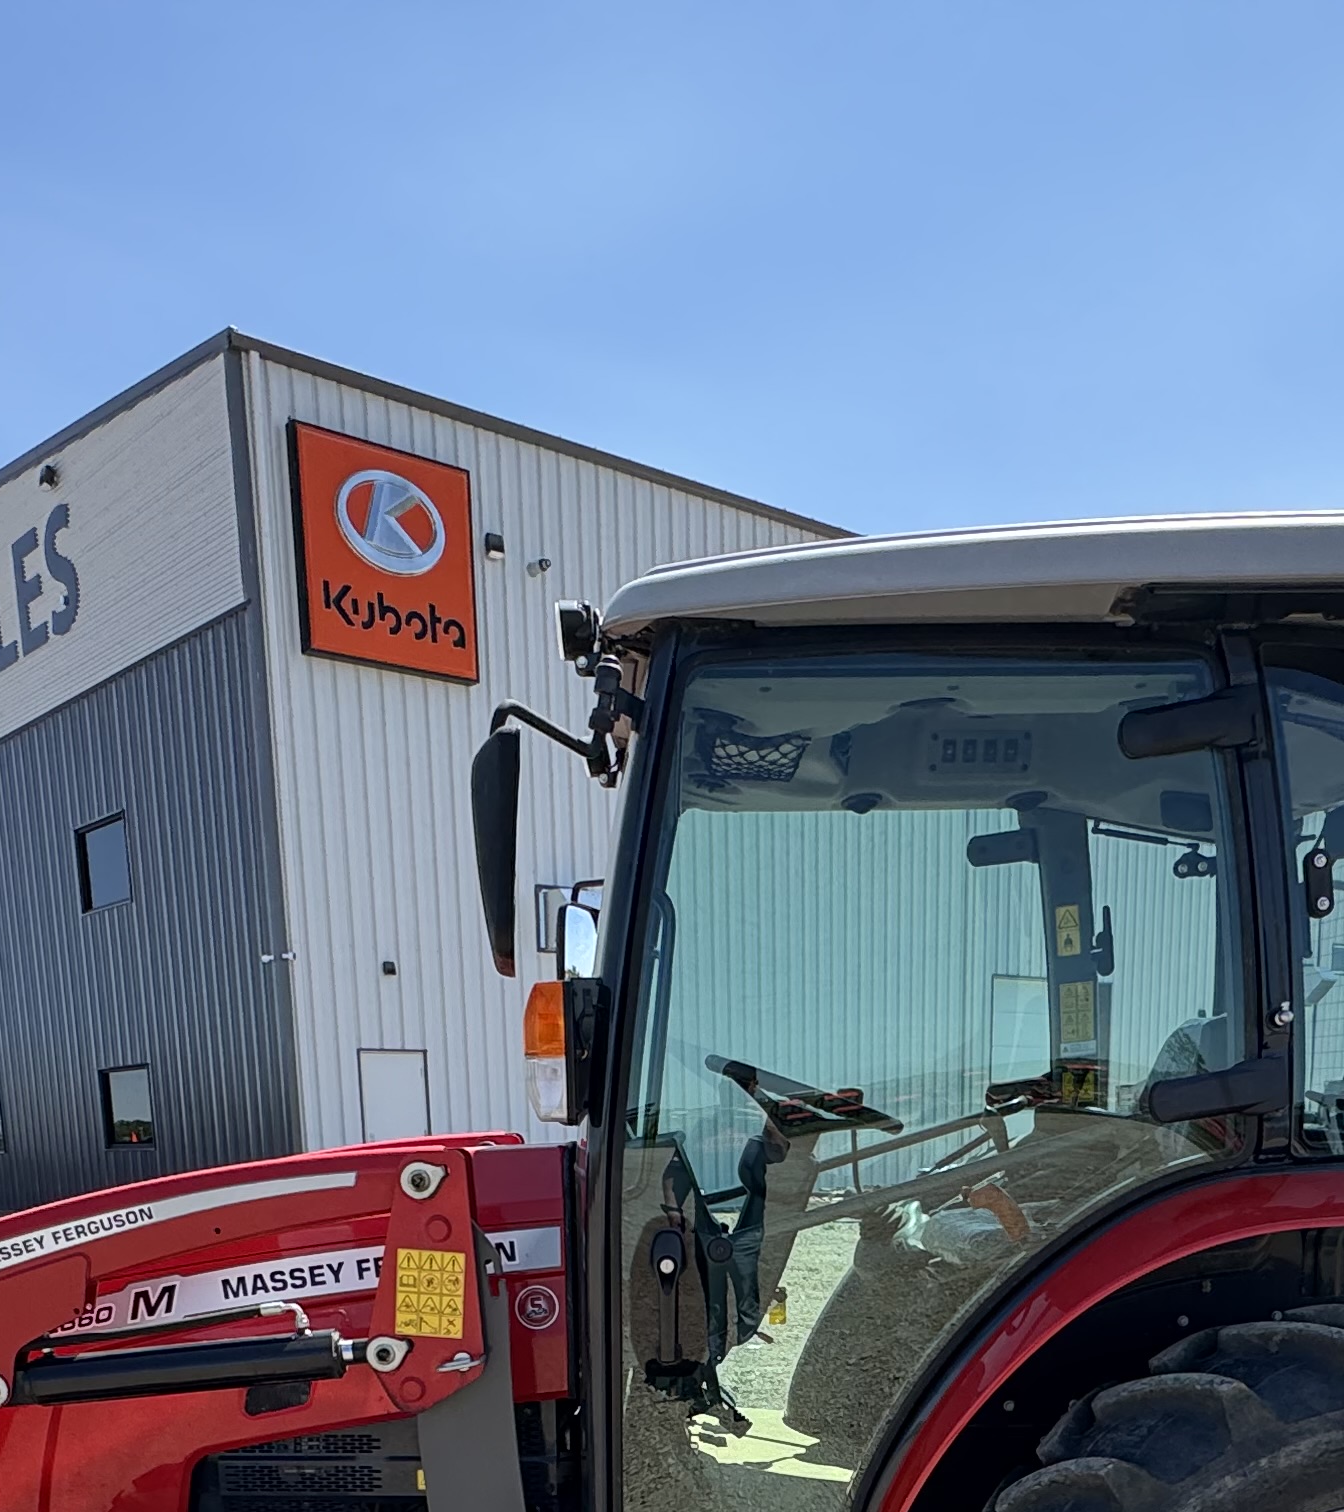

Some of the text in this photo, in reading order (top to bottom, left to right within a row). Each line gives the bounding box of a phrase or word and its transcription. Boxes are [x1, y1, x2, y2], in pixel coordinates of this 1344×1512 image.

[323, 579, 466, 650] Kubota
[51, 1206, 155, 1246] FERGUSON
[49, 1305, 115, 1334] 60
[130, 1283, 178, 1321] M
[221, 1261, 345, 1300] MASSEY
